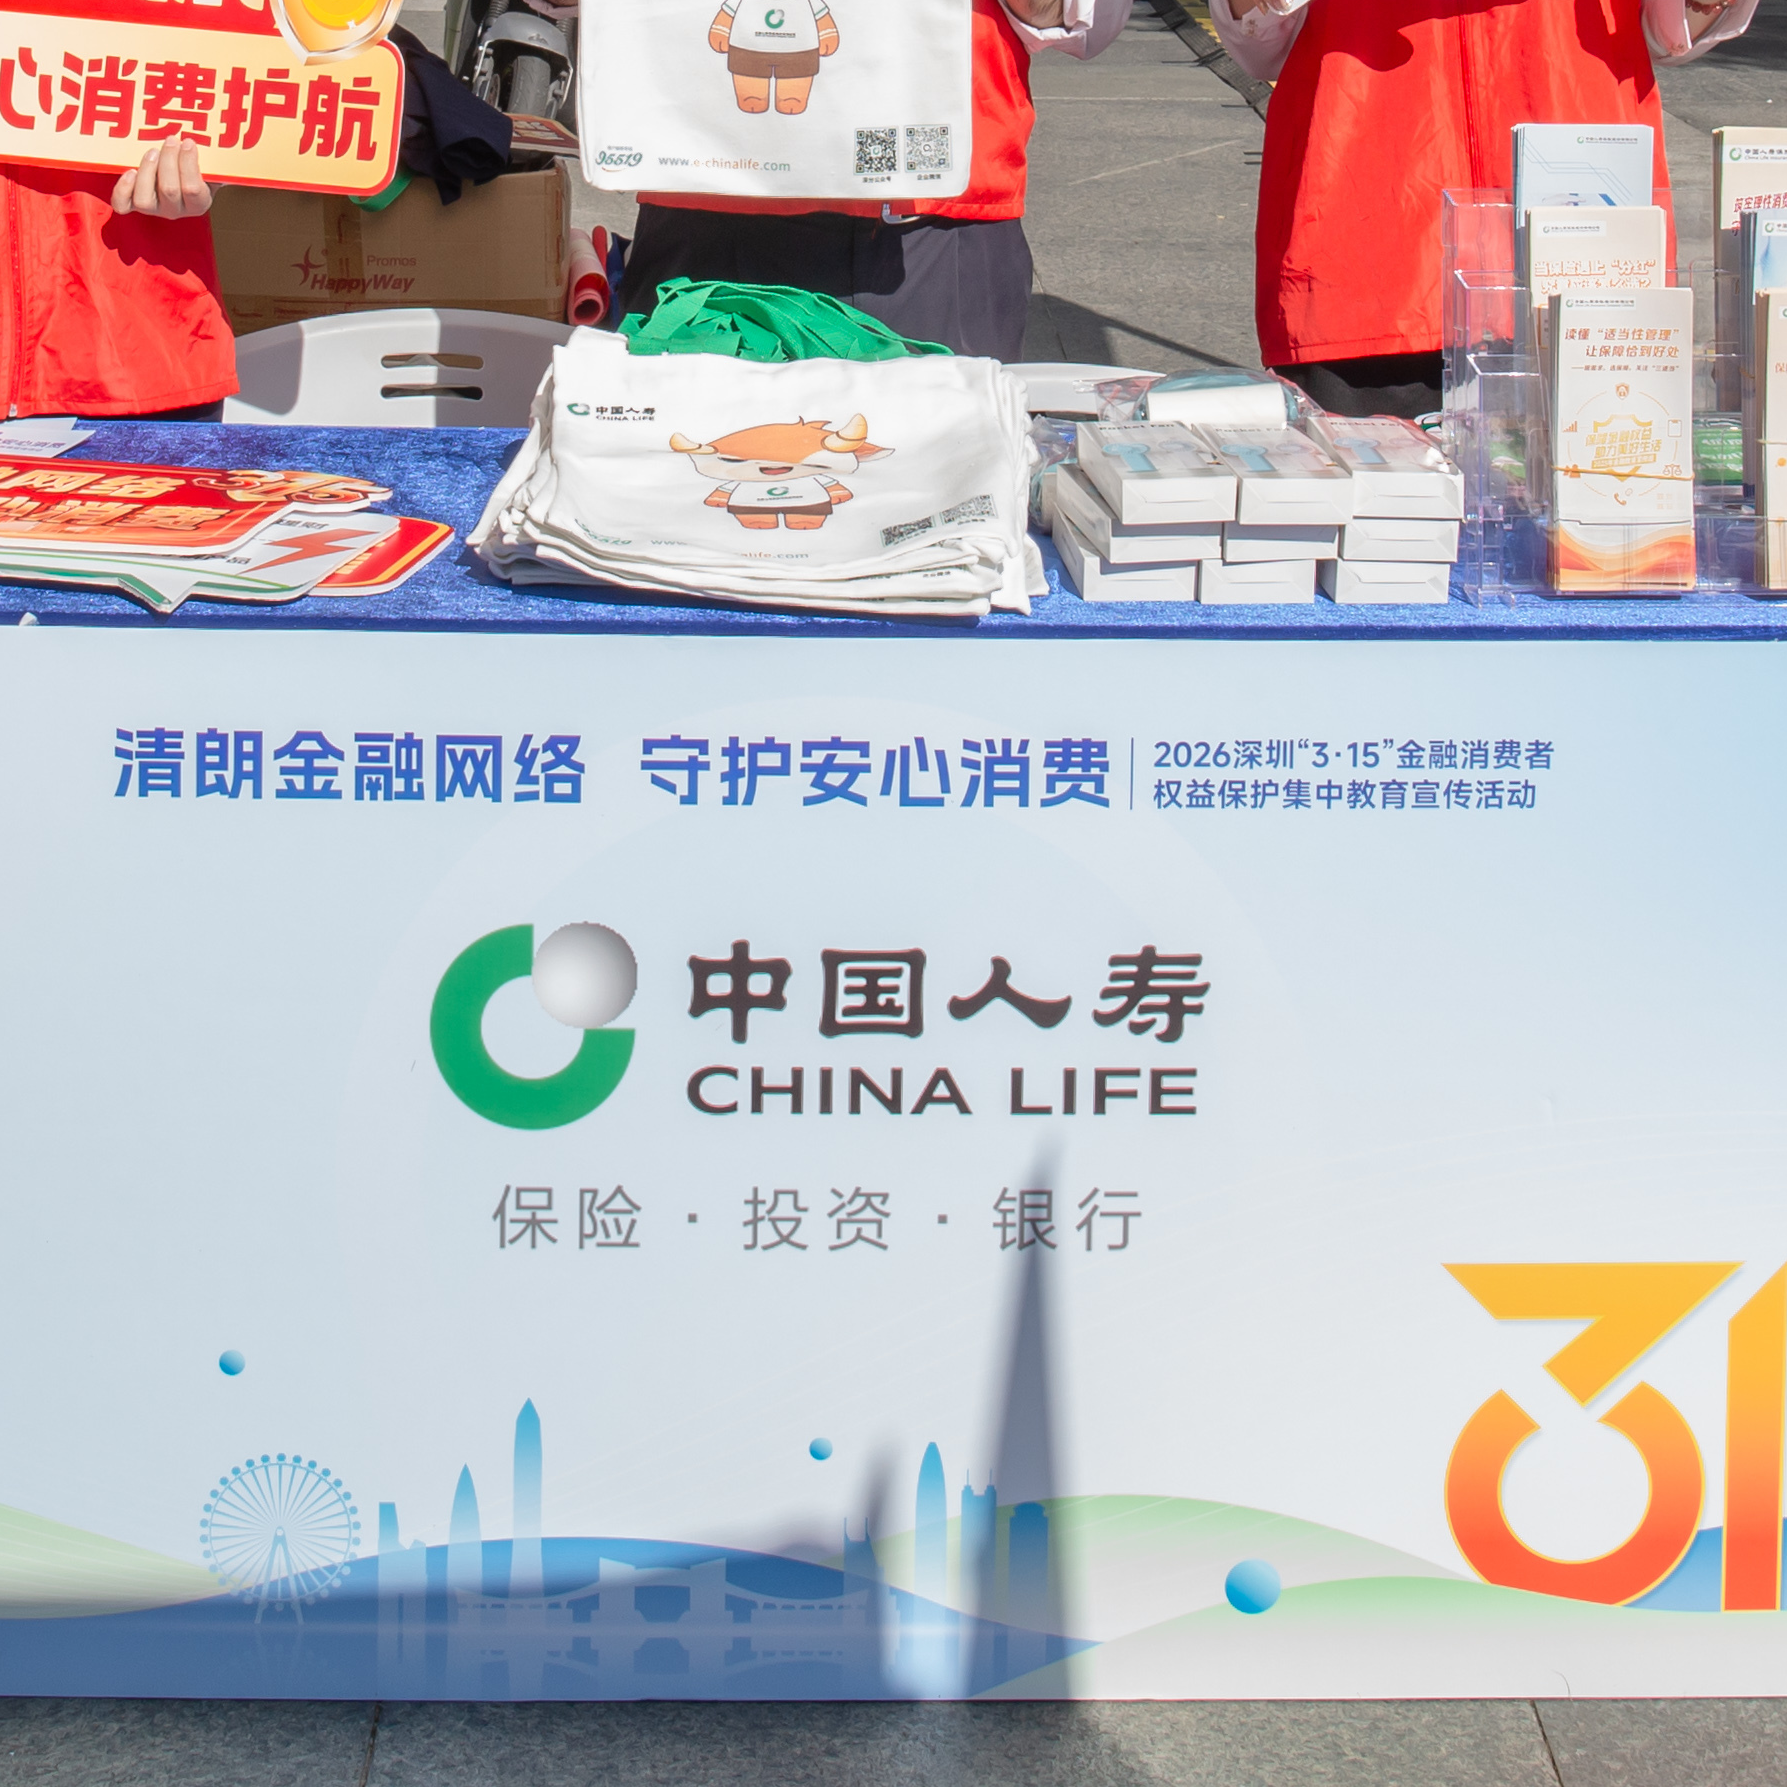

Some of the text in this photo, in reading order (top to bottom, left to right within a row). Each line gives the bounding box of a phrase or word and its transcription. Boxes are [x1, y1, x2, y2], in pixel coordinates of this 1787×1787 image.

[658, 155, 791, 172] www.e-chinalife.com
[367, 255, 416, 267] Promos
[1585, 345, 1680, 358] 让保障恰到好处
[596, 405, 656, 416] 中国人寿
[632, 414, 655, 422] LIFE
[113, 727, 1113, 810] 清朗金融网络 守护安心消费
[1152, 777, 1538, 813] 权益保护集中教育宣传活动
[686, 940, 1211, 1044] 中国人寿
[686, 1065, 1198, 1118] CHINA LIFE
